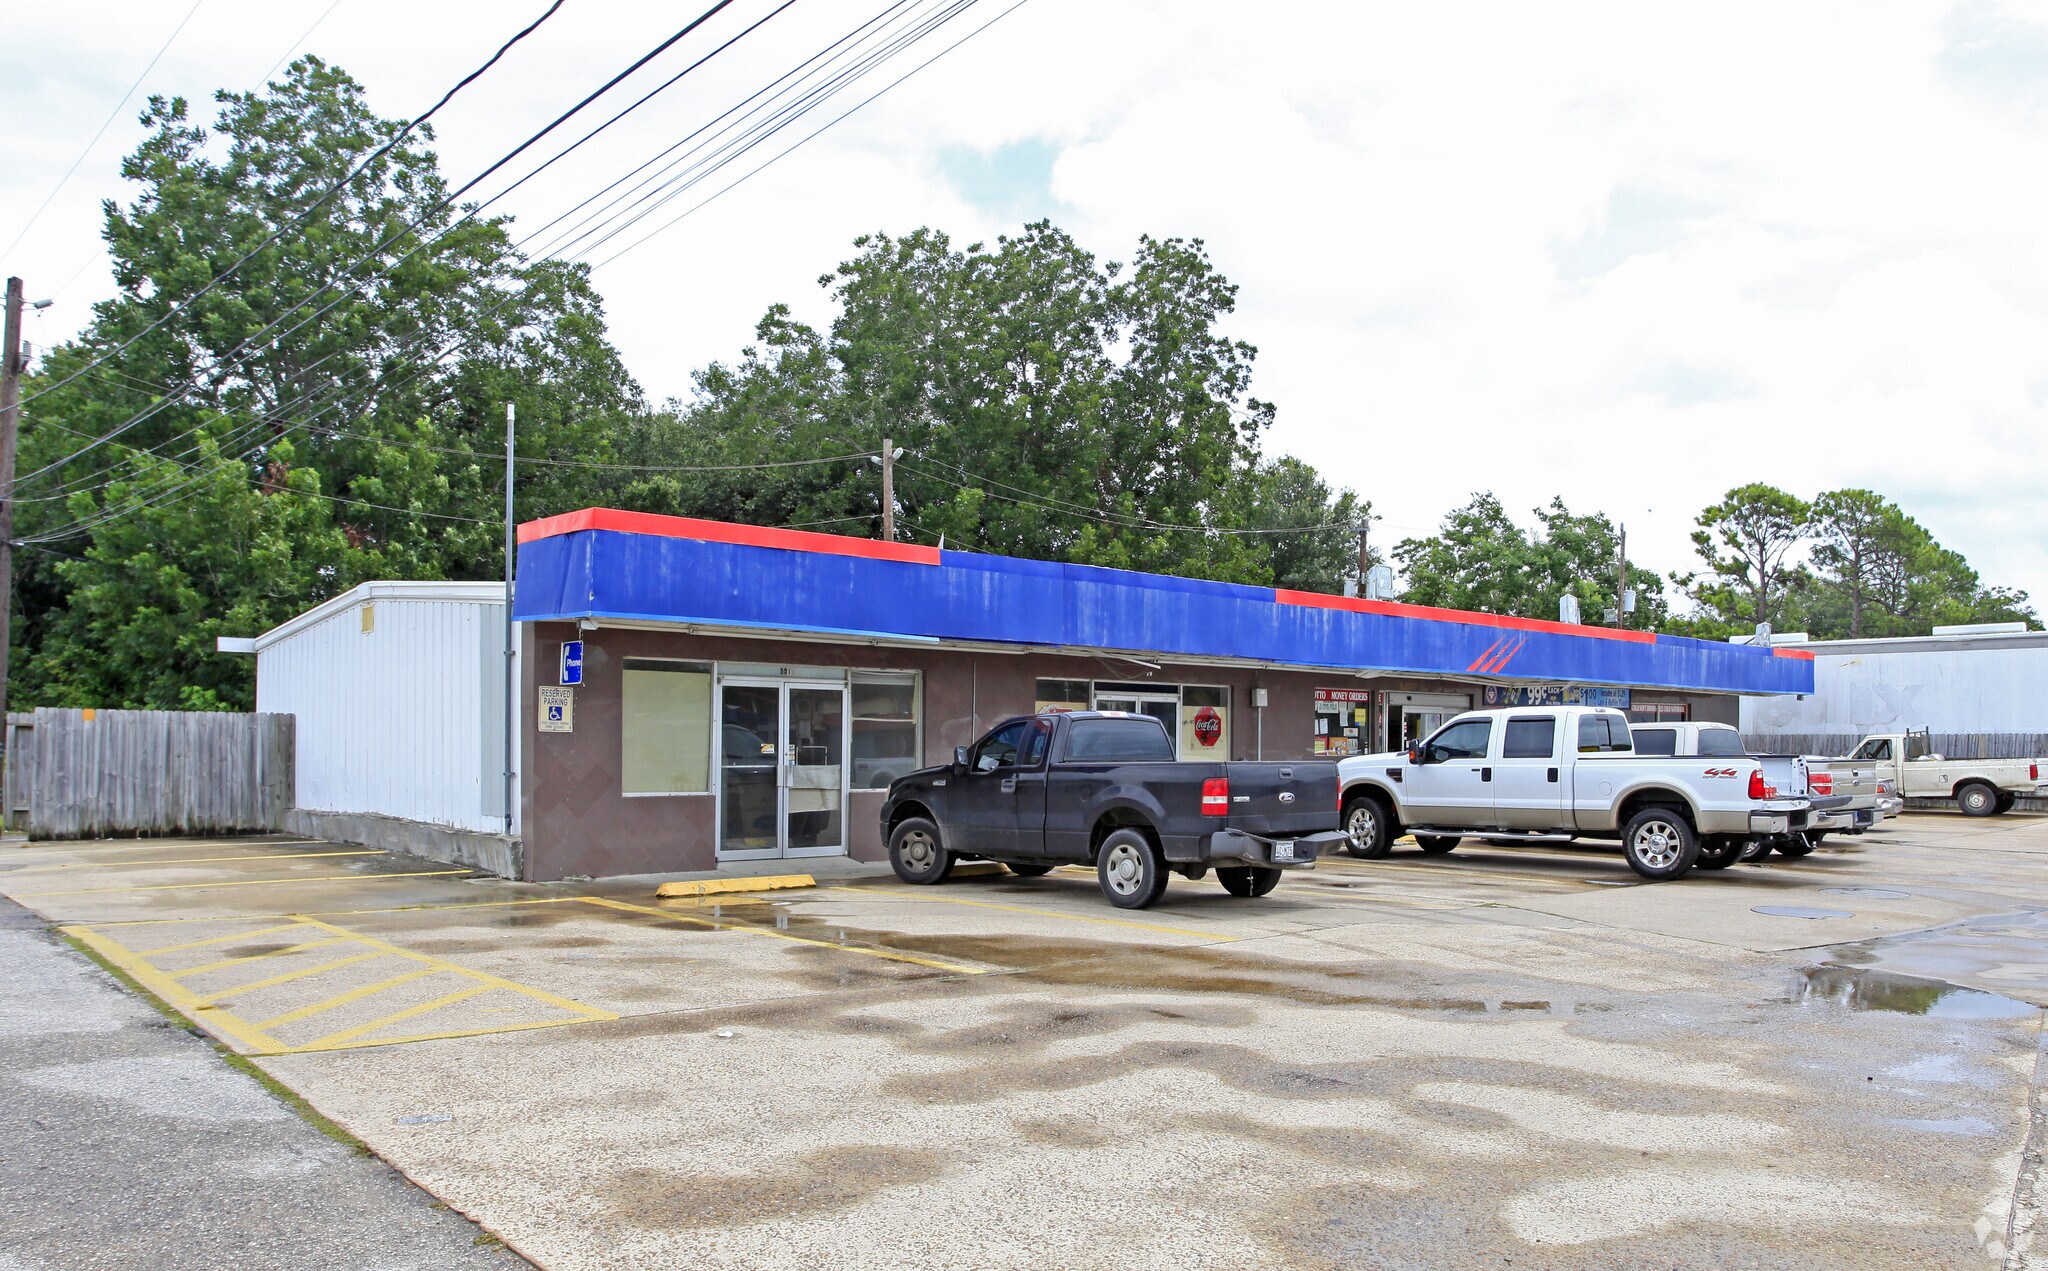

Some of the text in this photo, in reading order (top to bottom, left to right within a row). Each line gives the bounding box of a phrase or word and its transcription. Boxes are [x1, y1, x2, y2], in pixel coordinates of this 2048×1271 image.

[567, 659, 581, 667] Phone
[542, 689, 570, 698] RESERVED
[1315, 691, 1326, 700] TTO
[1331, 692, 1348, 700] MONEY
[1349, 692, 1368, 701] ORDERS
[544, 698, 568, 706] PARKING
